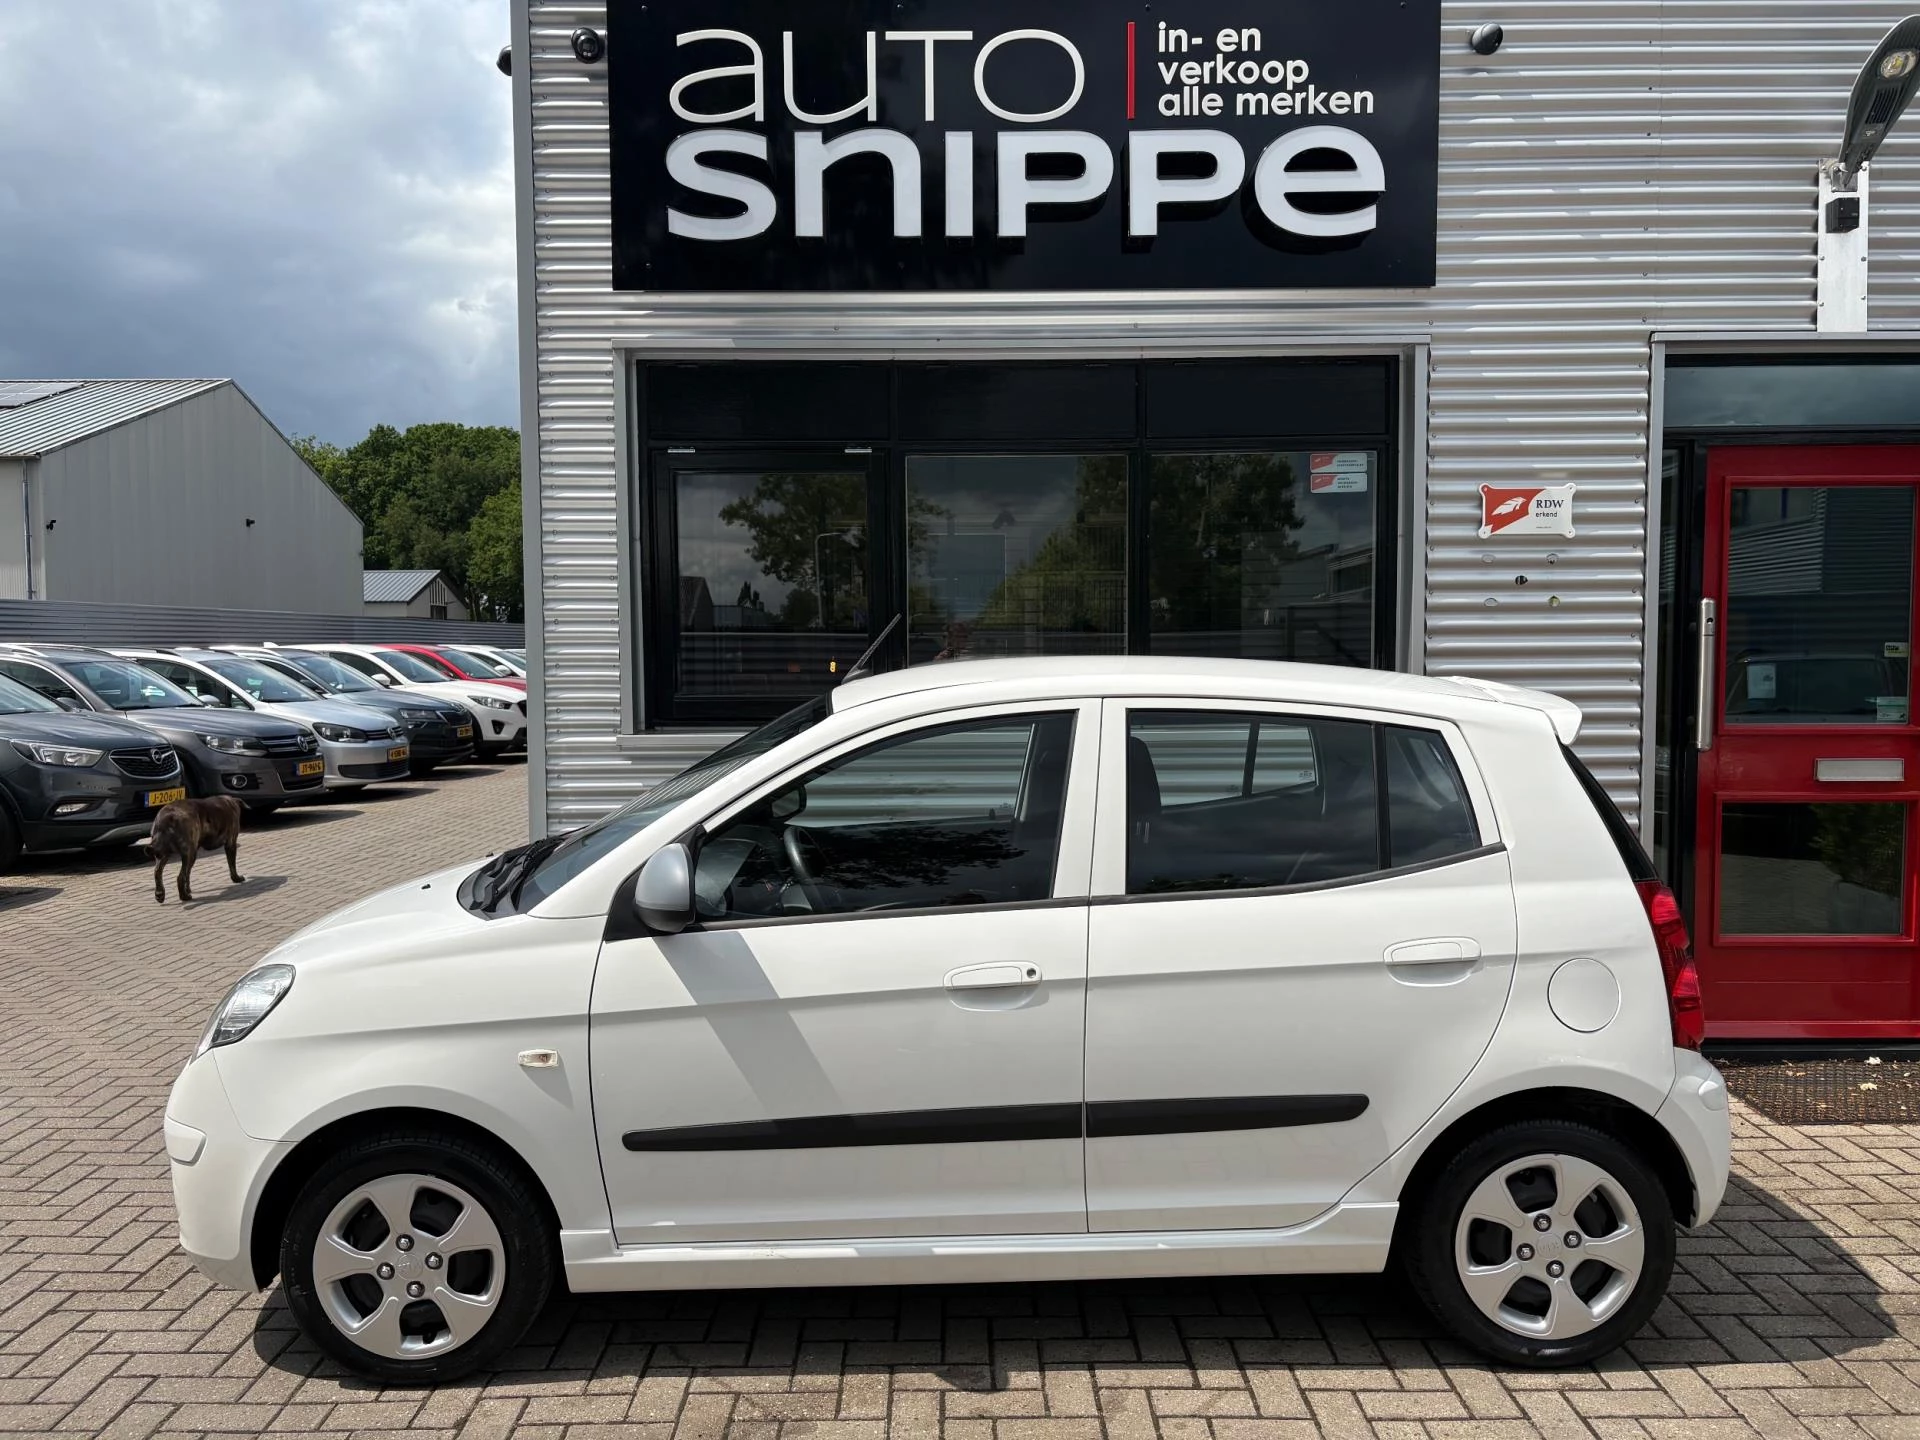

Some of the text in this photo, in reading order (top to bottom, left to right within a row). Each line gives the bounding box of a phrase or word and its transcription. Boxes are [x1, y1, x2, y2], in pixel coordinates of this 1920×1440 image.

[1158, 21, 1262, 53] in- en
[1157, 53, 1310, 91] verkoop
[1158, 84, 1375, 117] alle merken
[1535, 499, 1565, 509] RDW
